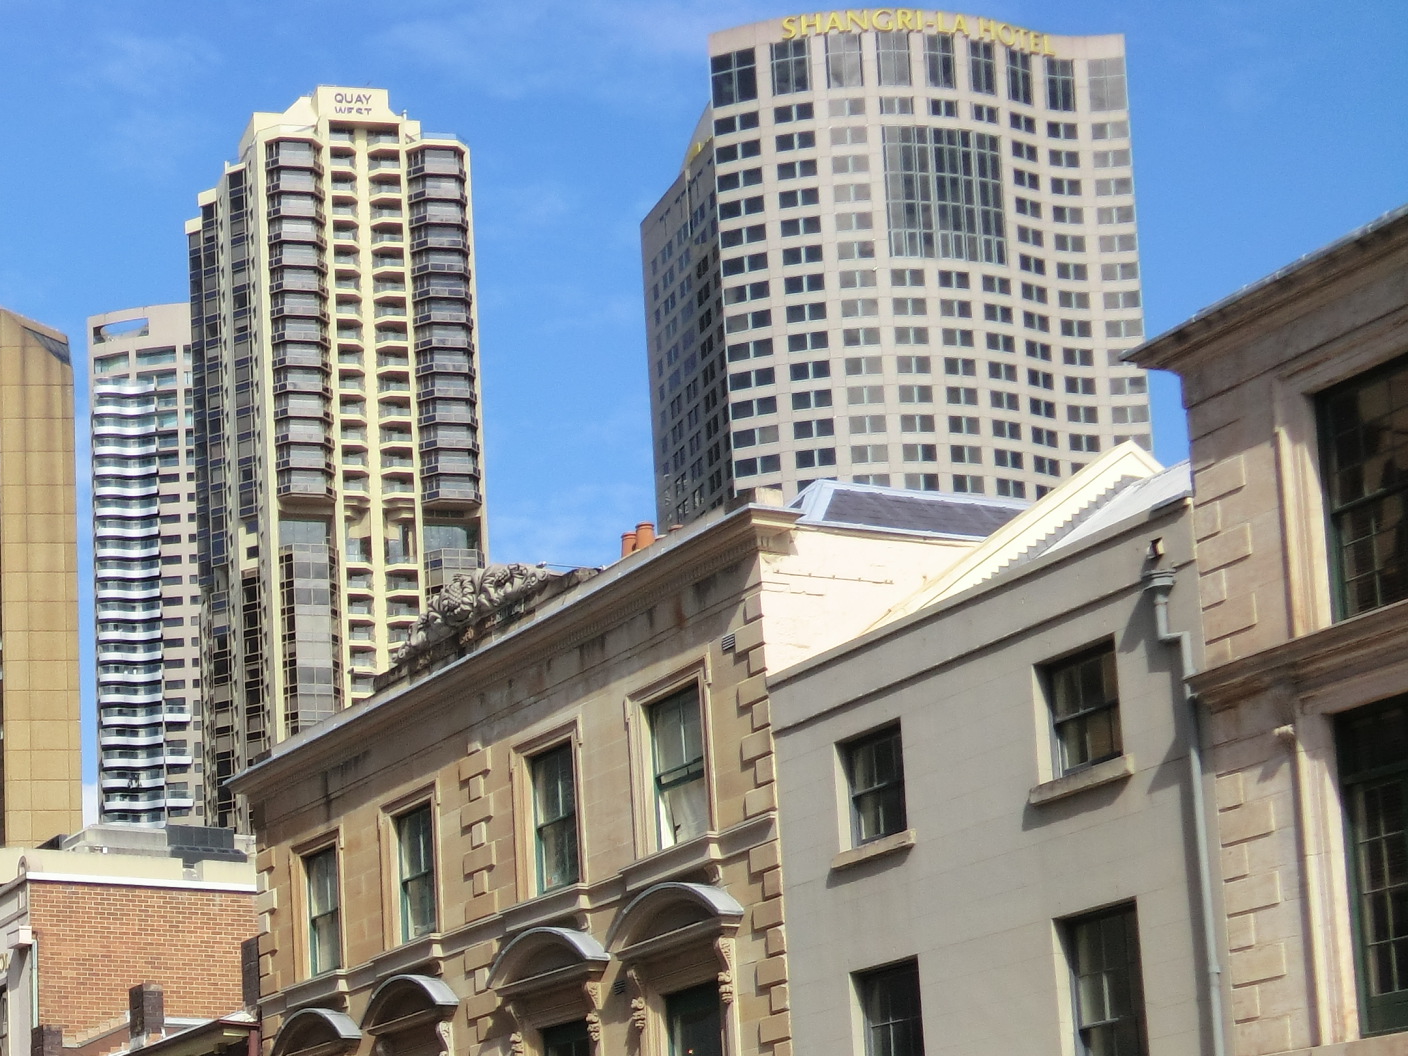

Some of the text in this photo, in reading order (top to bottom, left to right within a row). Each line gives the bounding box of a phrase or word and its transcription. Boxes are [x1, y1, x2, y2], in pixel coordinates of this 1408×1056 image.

[781, 8, 1055, 56] SHANGRI-LA HOTEL
[334, 93, 372, 104] QUAY
